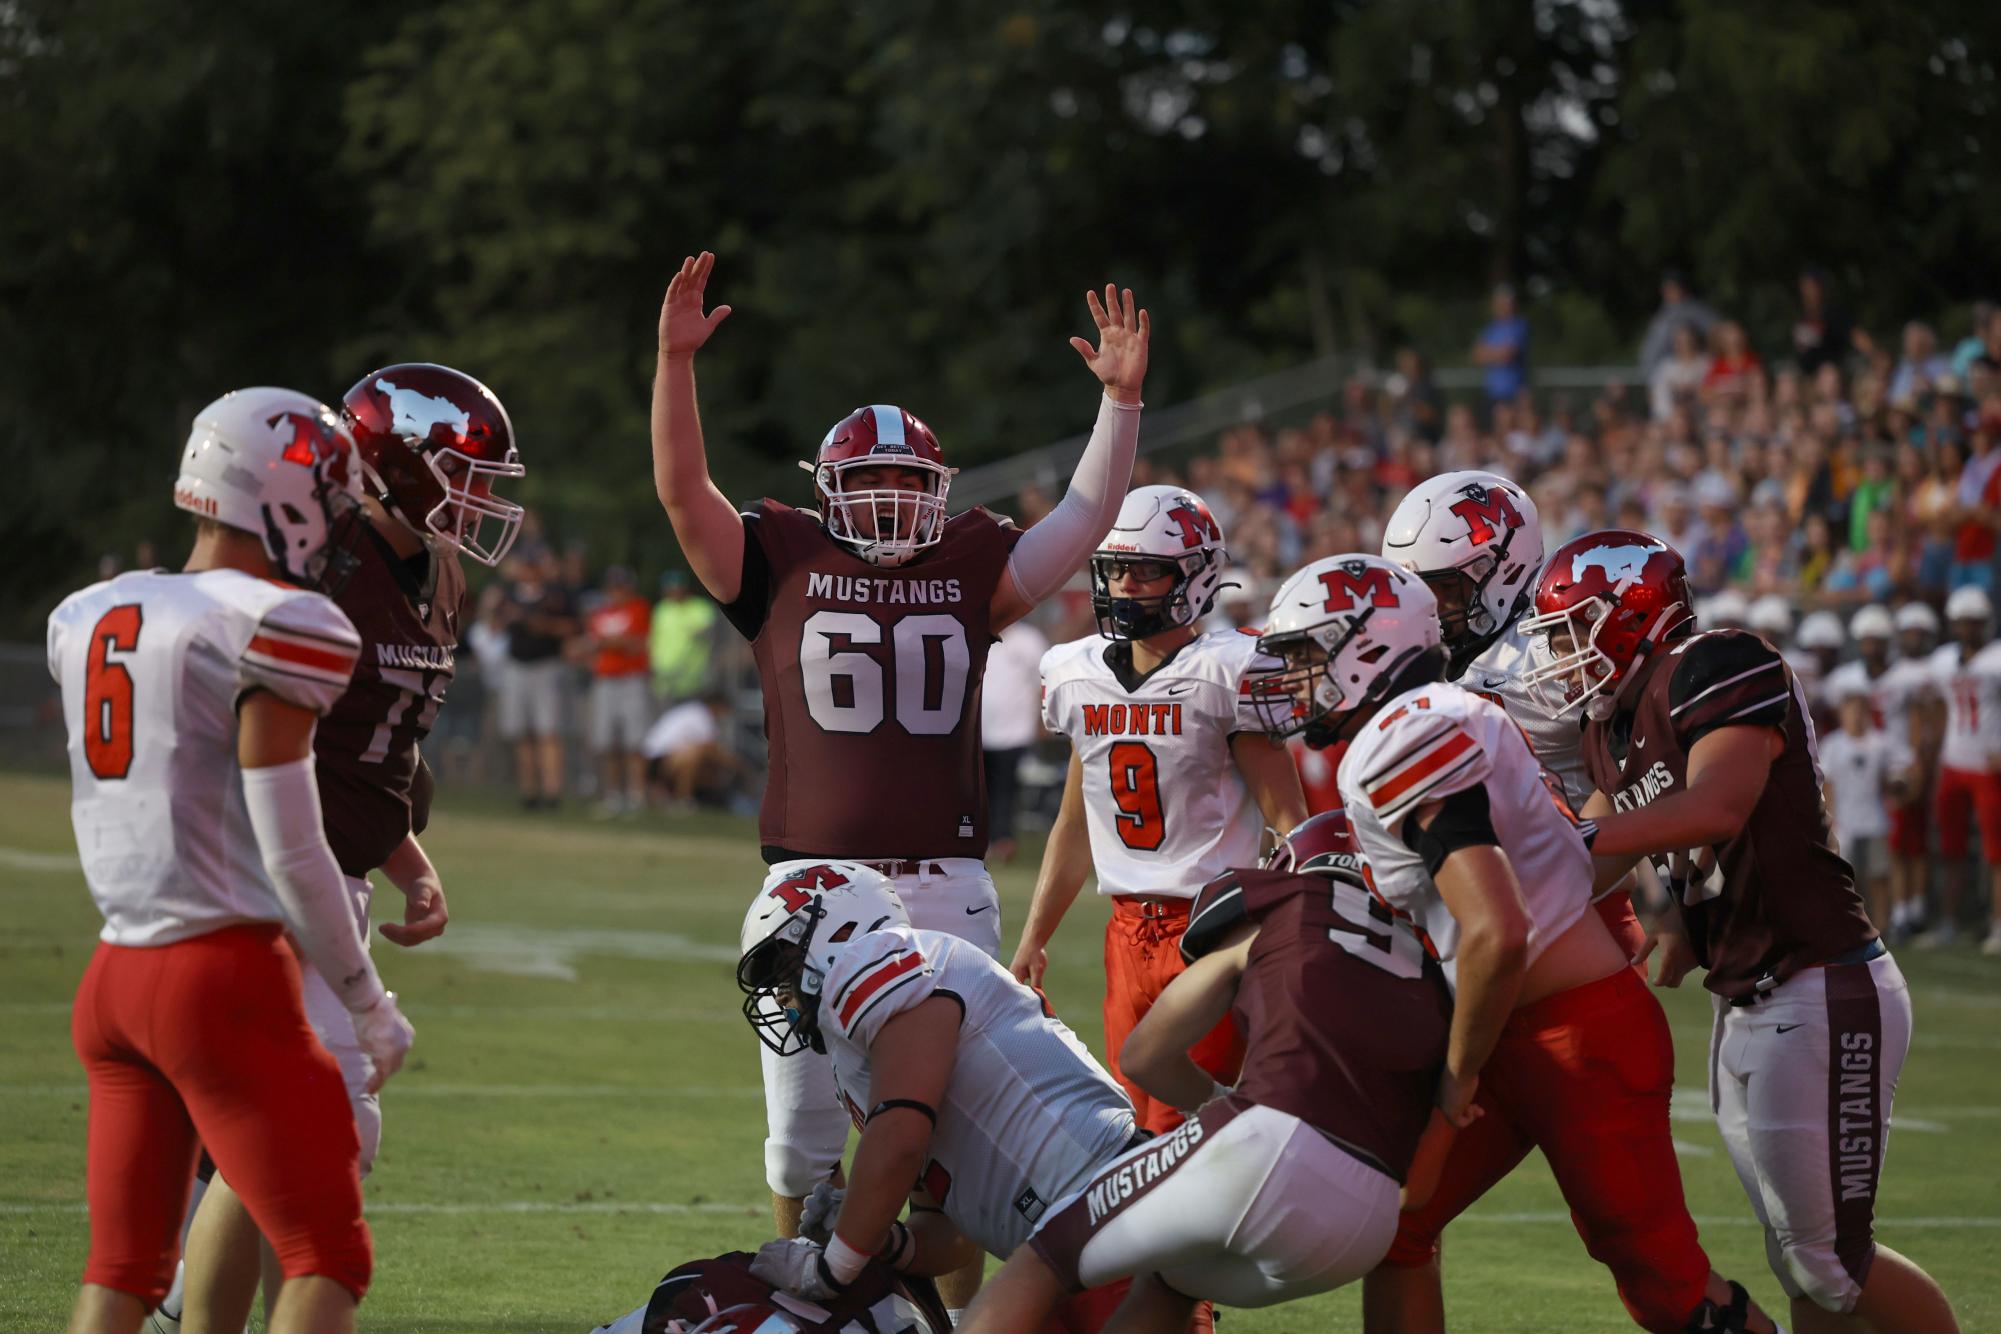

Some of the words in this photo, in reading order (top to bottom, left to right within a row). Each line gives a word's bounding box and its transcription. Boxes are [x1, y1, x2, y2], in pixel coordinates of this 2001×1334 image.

[1166, 506, 1221, 550] M
[1449, 486, 1526, 547] M
[806, 572, 962, 604] MUSTANGS
[1317, 567, 1400, 614] M
[84, 603, 143, 780] 6
[799, 609, 972, 737] 60
[1082, 703, 1182, 737] MONTI
[962, 815, 971, 824] XL
[1108, 741, 1167, 852] 9
[768, 863, 850, 915] M
[1839, 1032, 1873, 1202] MUSTANGS
[1086, 1116, 1204, 1227] MUSTANGS
